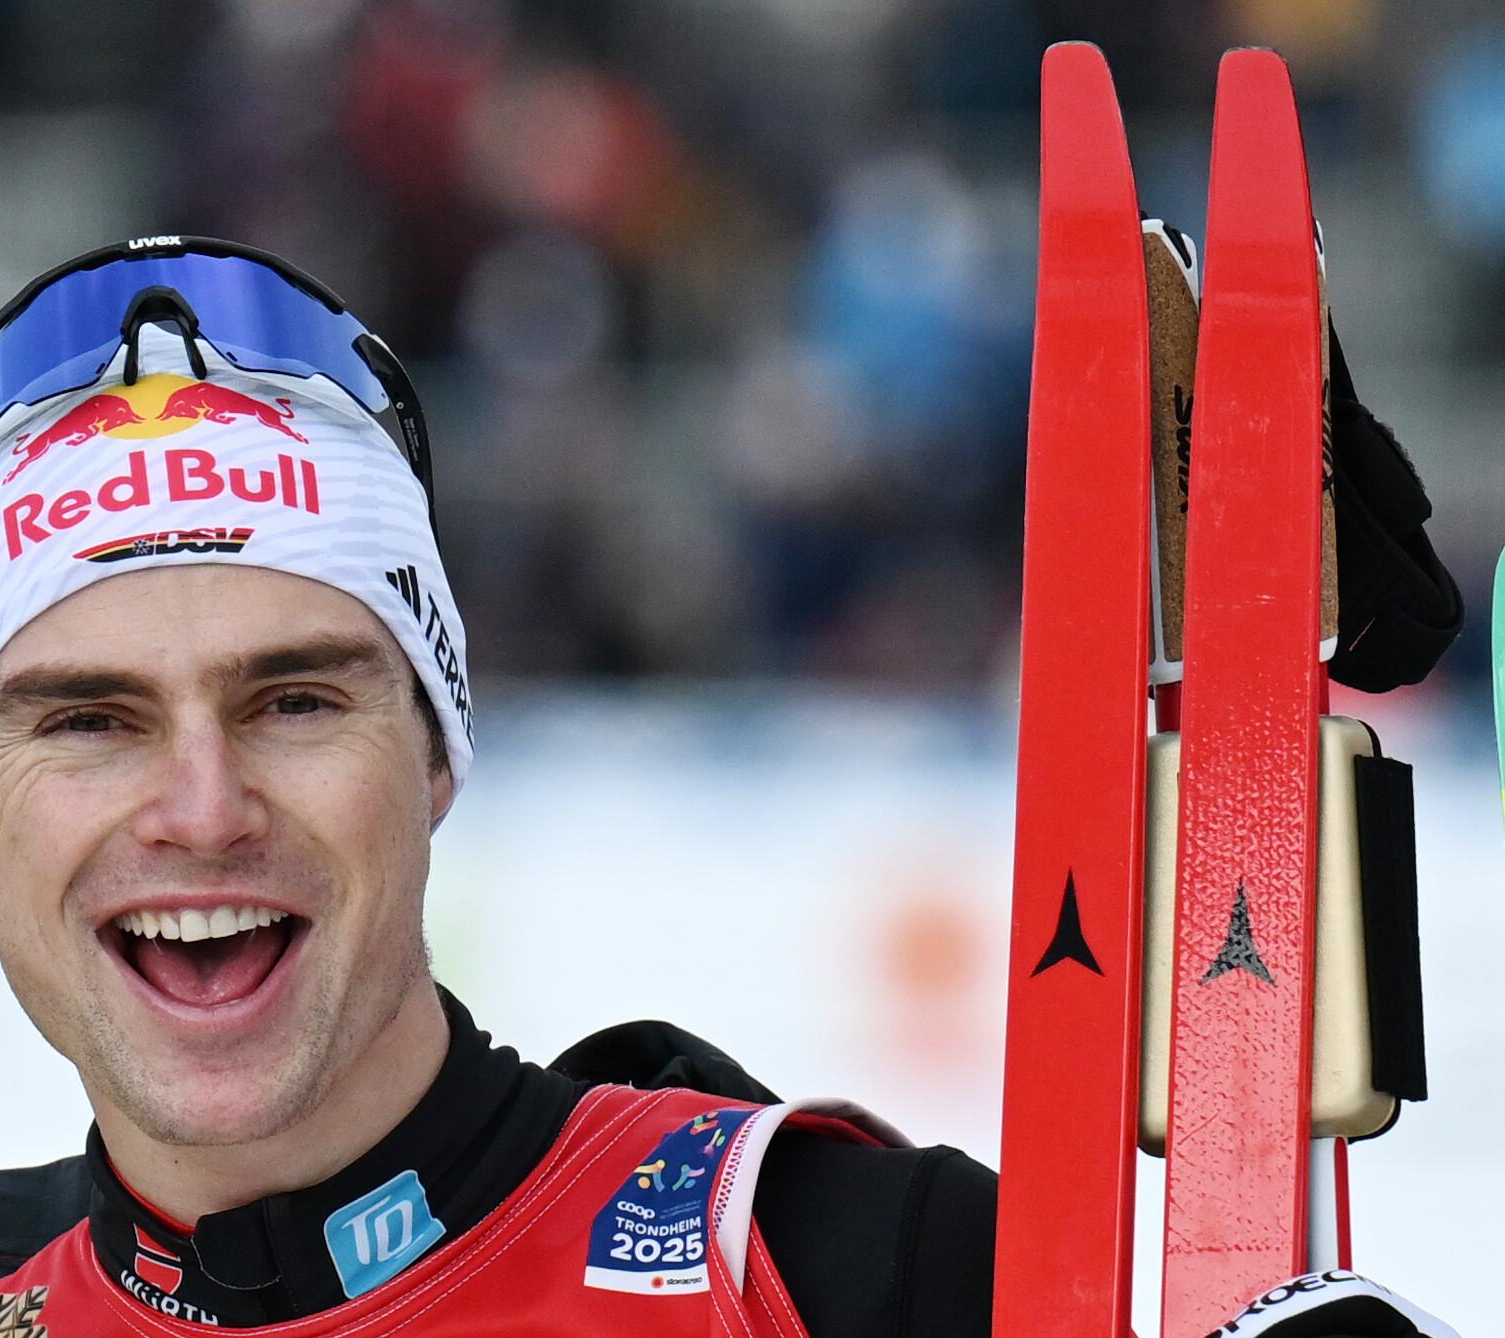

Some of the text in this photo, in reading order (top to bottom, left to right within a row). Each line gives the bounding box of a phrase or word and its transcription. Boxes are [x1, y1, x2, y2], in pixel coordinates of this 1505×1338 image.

[127, 233, 182, 250] uvex
[1, 450, 152, 562] Red
[164, 448, 321, 516] Bull
[616, 1200, 656, 1221] coop
[615, 1215, 702, 1238] TRONDHEIM
[609, 1231, 705, 1264] 2025
